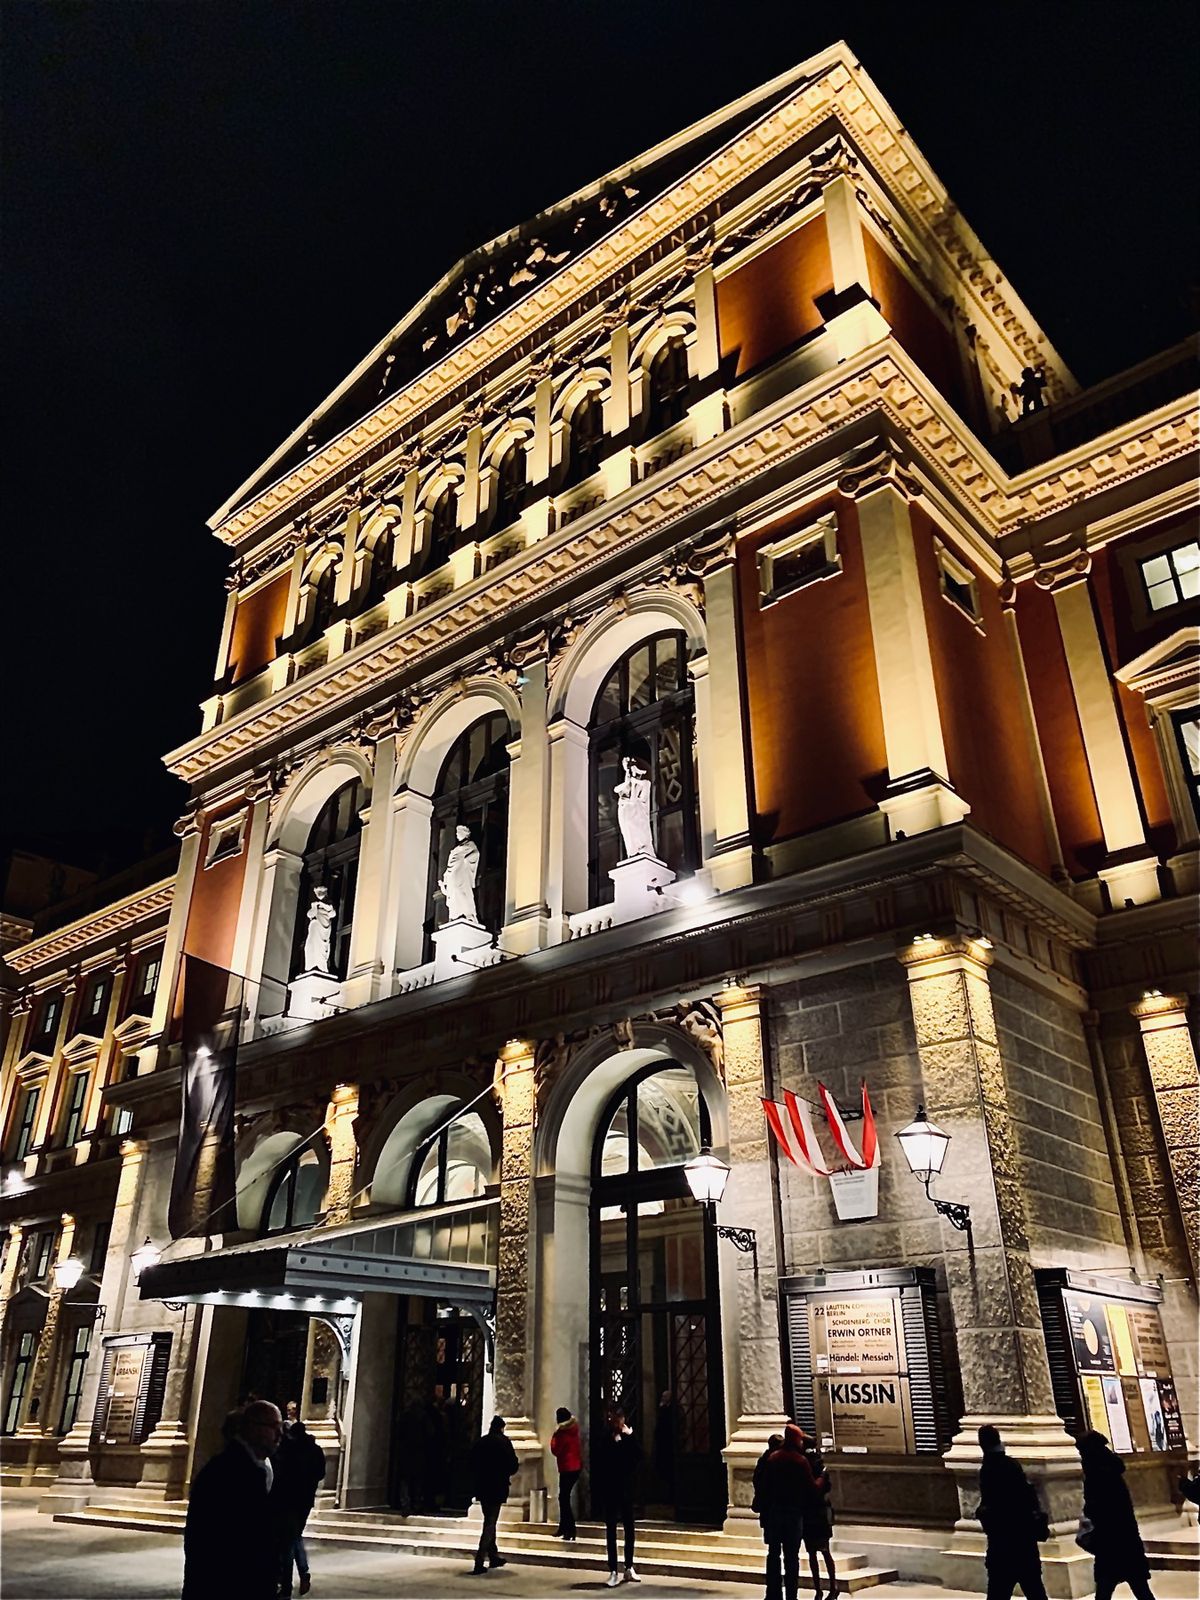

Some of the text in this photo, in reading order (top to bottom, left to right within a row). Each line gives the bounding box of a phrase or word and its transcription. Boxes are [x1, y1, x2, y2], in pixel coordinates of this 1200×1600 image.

[814, 1307, 825, 1316] 22
[828, 1328, 891, 1338] ERWIN ORTNER
[829, 1351, 894, 1362] Händel: Messiah
[831, 1383, 895, 1404] KISSIN
